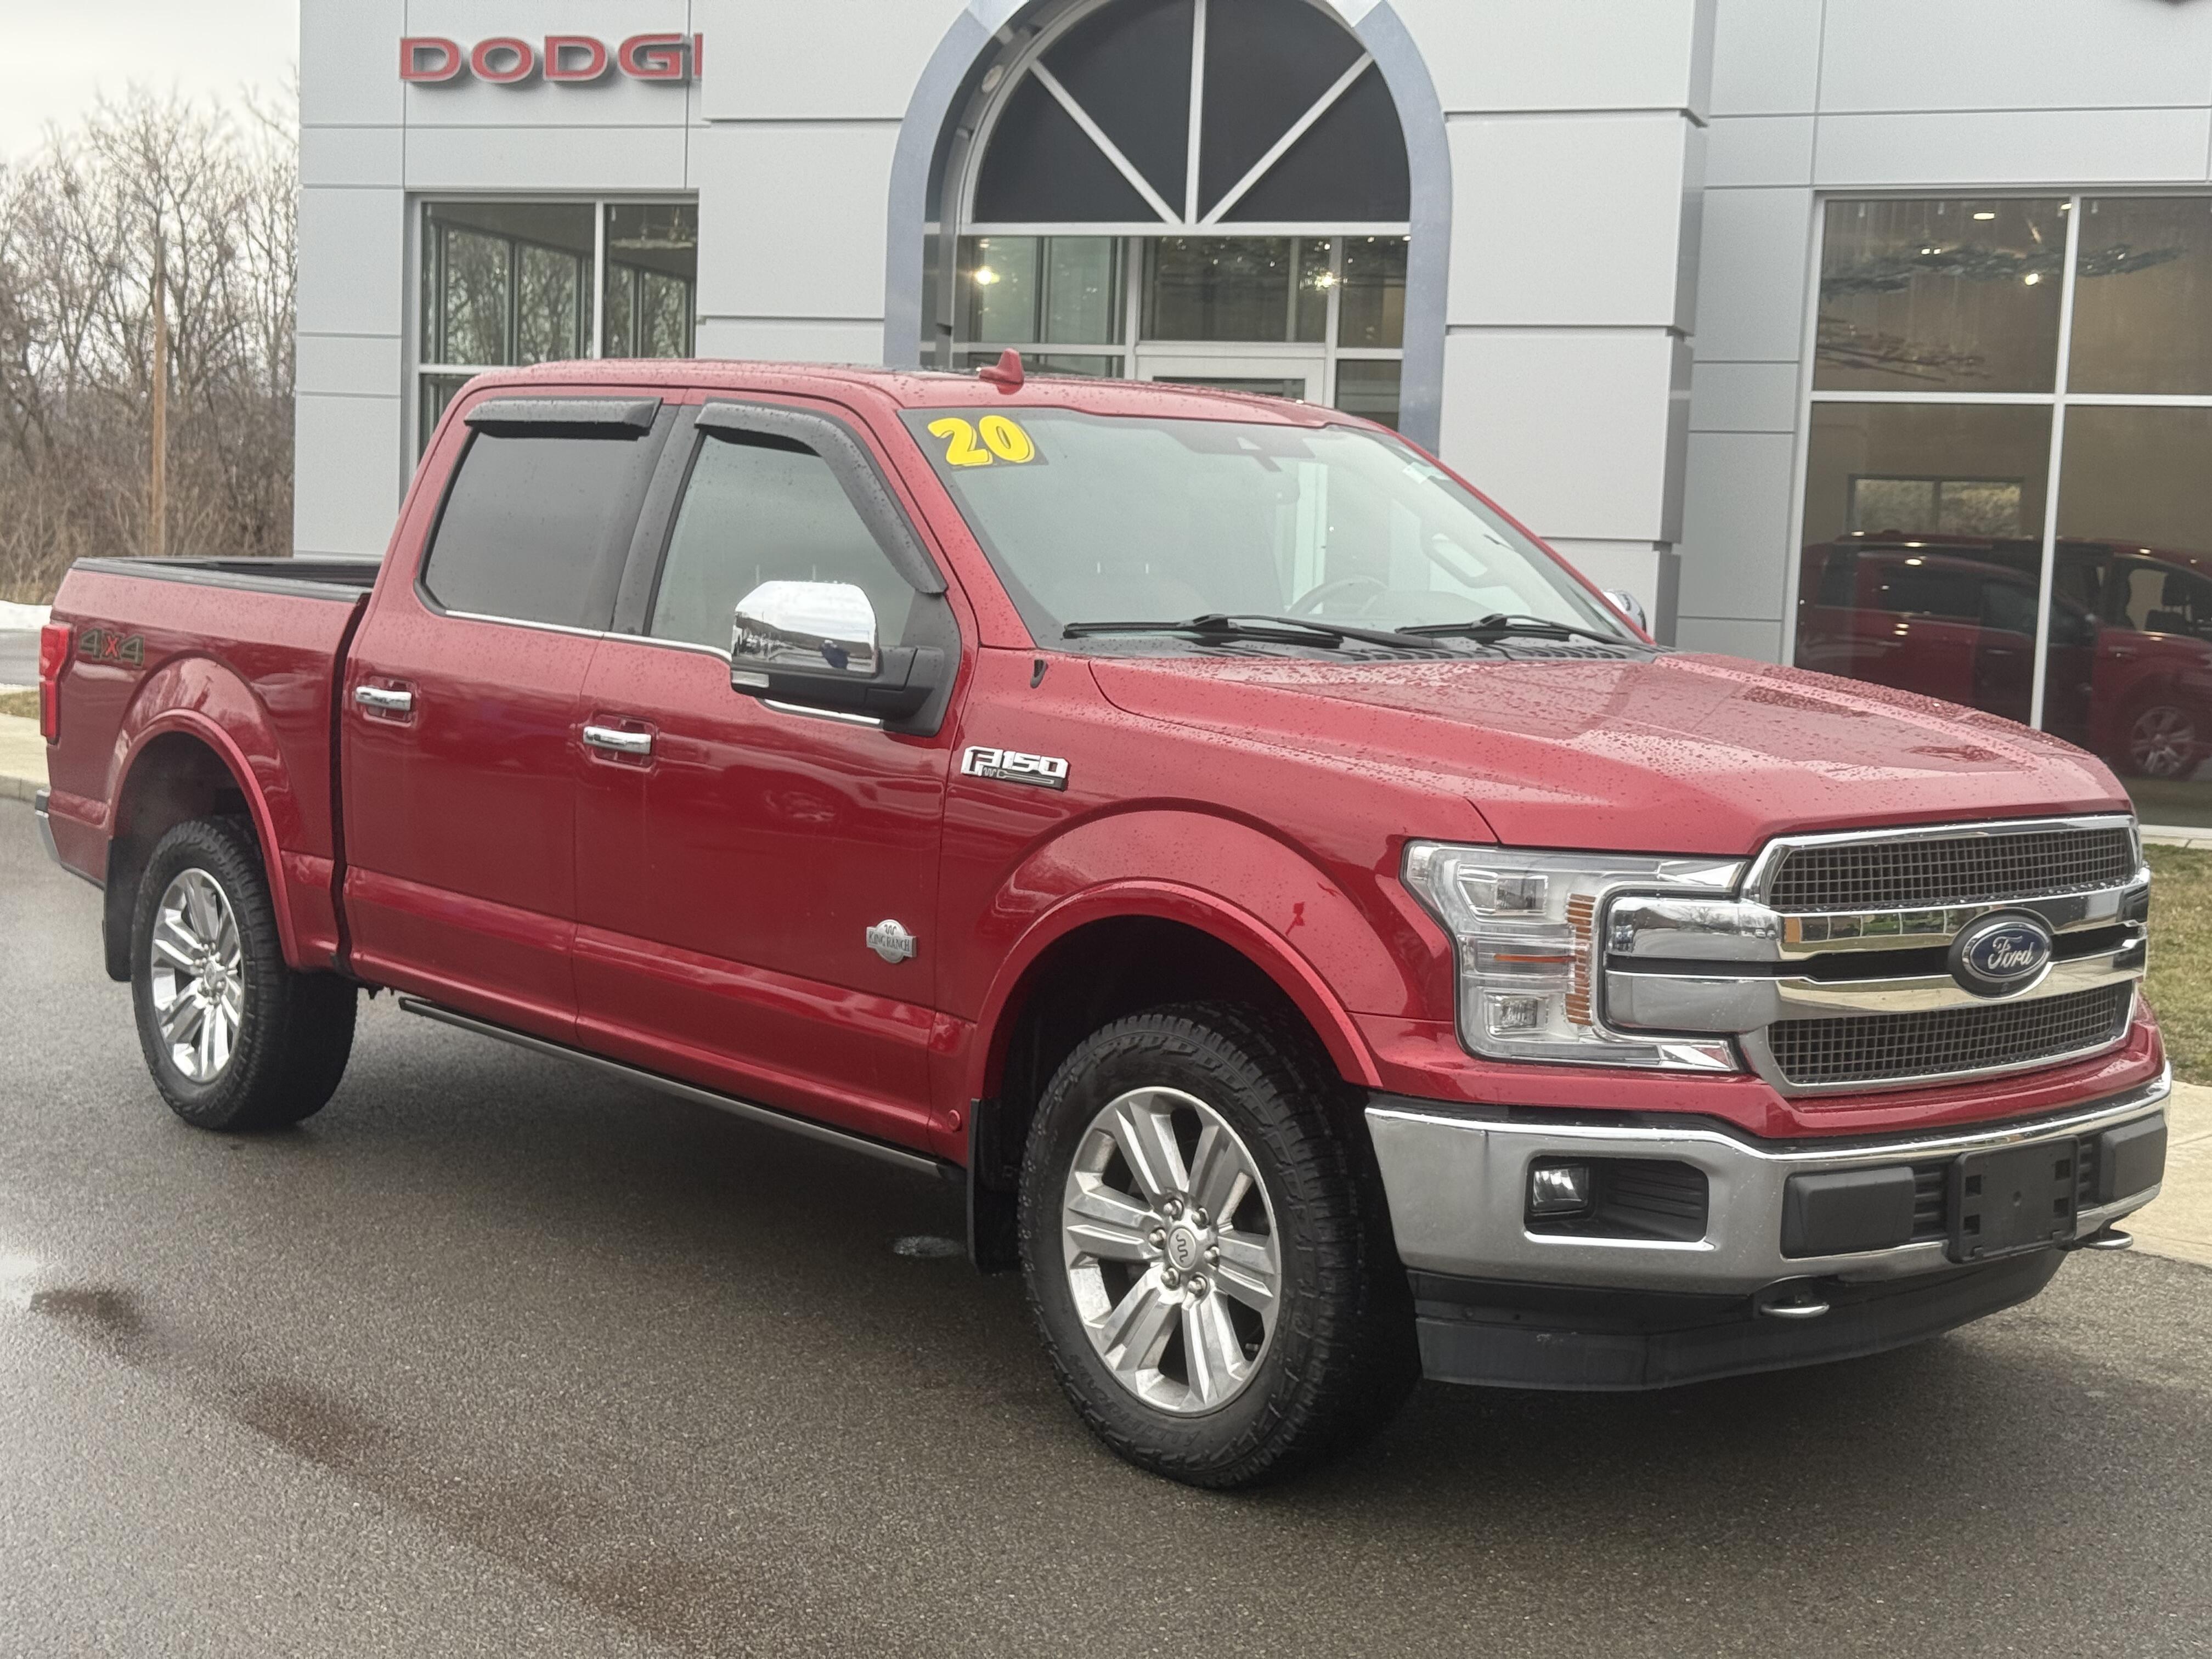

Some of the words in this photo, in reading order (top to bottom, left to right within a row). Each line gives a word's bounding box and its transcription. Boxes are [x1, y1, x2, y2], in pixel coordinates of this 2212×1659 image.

[399, 33, 703, 82] DODG
[927, 415, 1035, 466] 20
[869, 931, 885, 947] KING
[887, 936, 910, 952] RANCH
[1988, 935, 2035, 969] Ford
